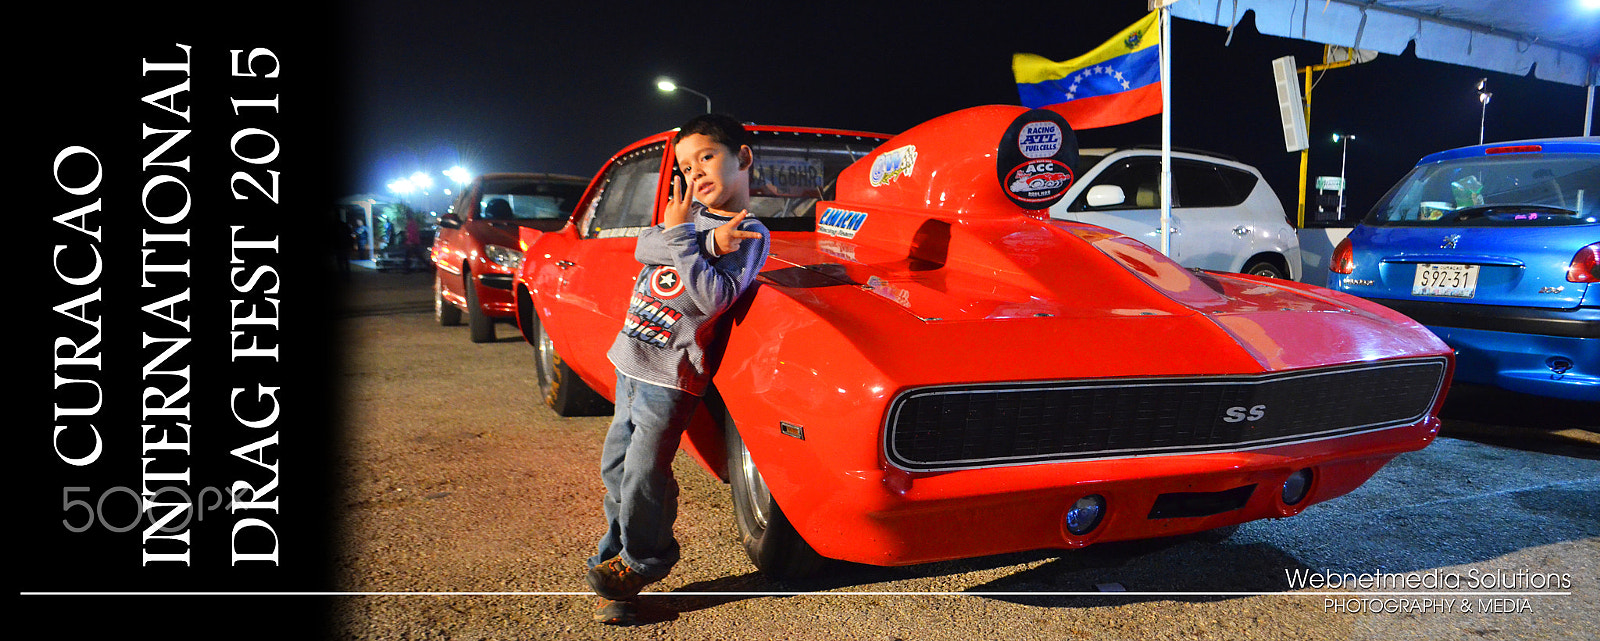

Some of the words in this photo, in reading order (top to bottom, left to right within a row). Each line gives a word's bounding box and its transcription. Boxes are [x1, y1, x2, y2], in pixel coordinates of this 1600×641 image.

[1027, 126, 1055, 134] RACING
[1020, 133, 1058, 144] ATL
[1025, 144, 1040, 152] FUEL
[1040, 143, 1057, 151] CELLS
[1026, 163, 1054, 173] ACC
[1223, 404, 1266, 423] SS
